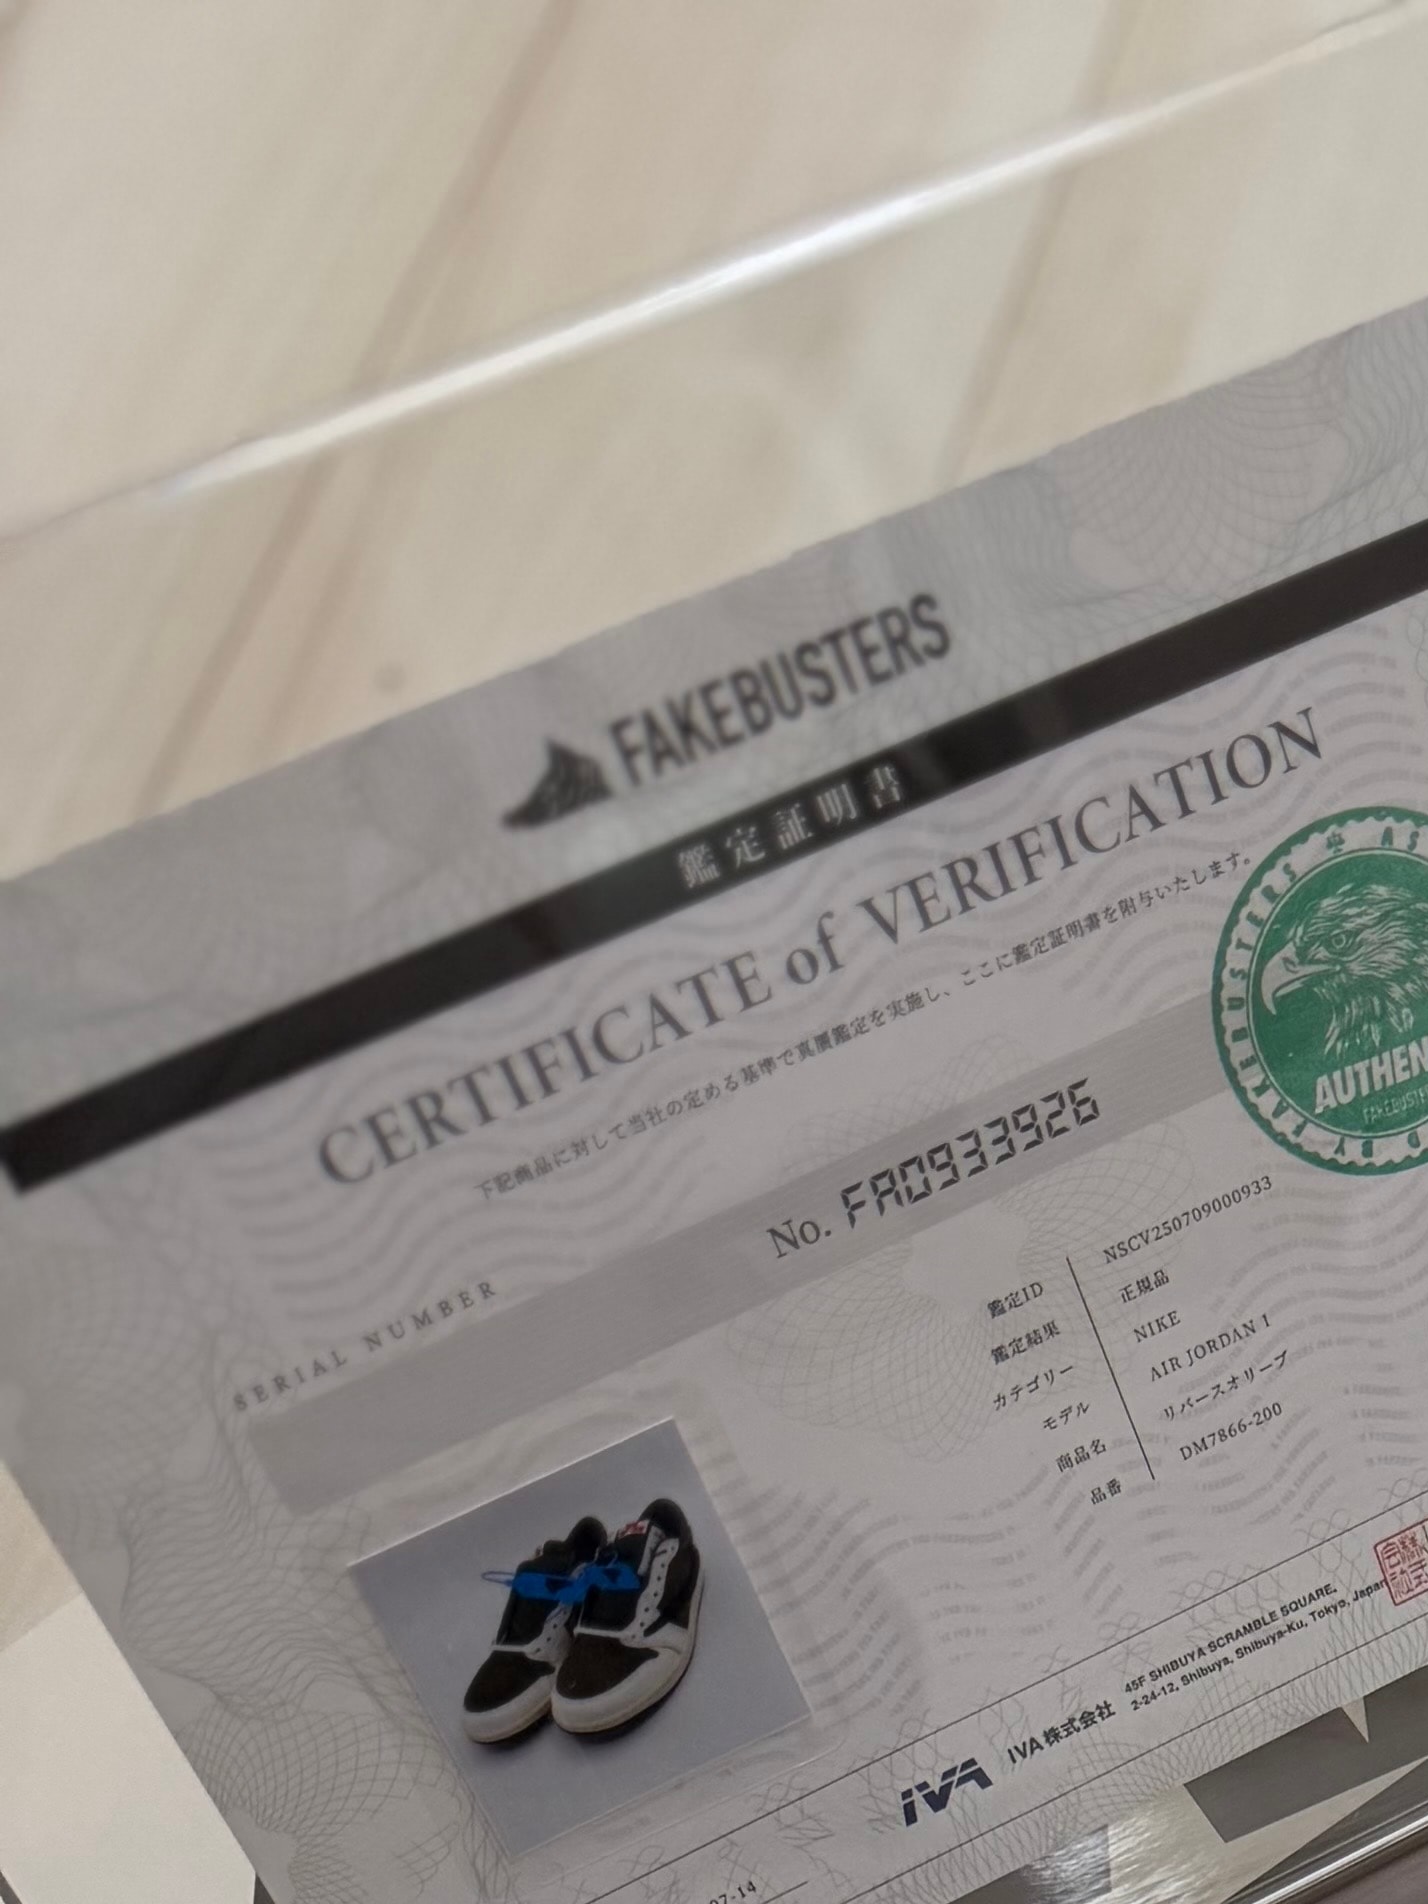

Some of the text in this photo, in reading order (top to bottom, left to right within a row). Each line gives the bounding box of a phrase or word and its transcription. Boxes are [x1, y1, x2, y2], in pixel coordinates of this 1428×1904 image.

[608, 593, 952, 788] FAKEBUSTERS
[677, 764, 903, 890] 鑑定証明書
[318, 706, 1325, 1186] CERTIFICATE of VERIFICATION
[766, 1078, 1102, 1260] No. FA0933926
[1118, 1269, 1170, 1305] 正規品
[233, 1280, 499, 1412] SERIAL NUMBER
[990, 1320, 1061, 1366] 鑑定結果
[1132, 1310, 1182, 1344] NIKE
[1149, 1313, 1271, 1383] AIR JORDAN 1
[991, 1365, 1075, 1412] カテゴリー
[1042, 1401, 1091, 1432] モデル
[1055, 1438, 1107, 1473] 商品名
[1179, 1401, 1283, 1462] DM7866-200
[1089, 1478, 1123, 1505] 品番
[1124, 1675, 1148, 1694] 45F
[1149, 1645, 1207, 1683] SHIBUYA
[1207, 1610, 1278, 1653] SCRAMBLE
[1181, 1656, 1235, 1688] Shibuya,
[1309, 1600, 1351, 1623] Tokyo,
[1007, 1698, 1117, 1766] IVA 株式会社
